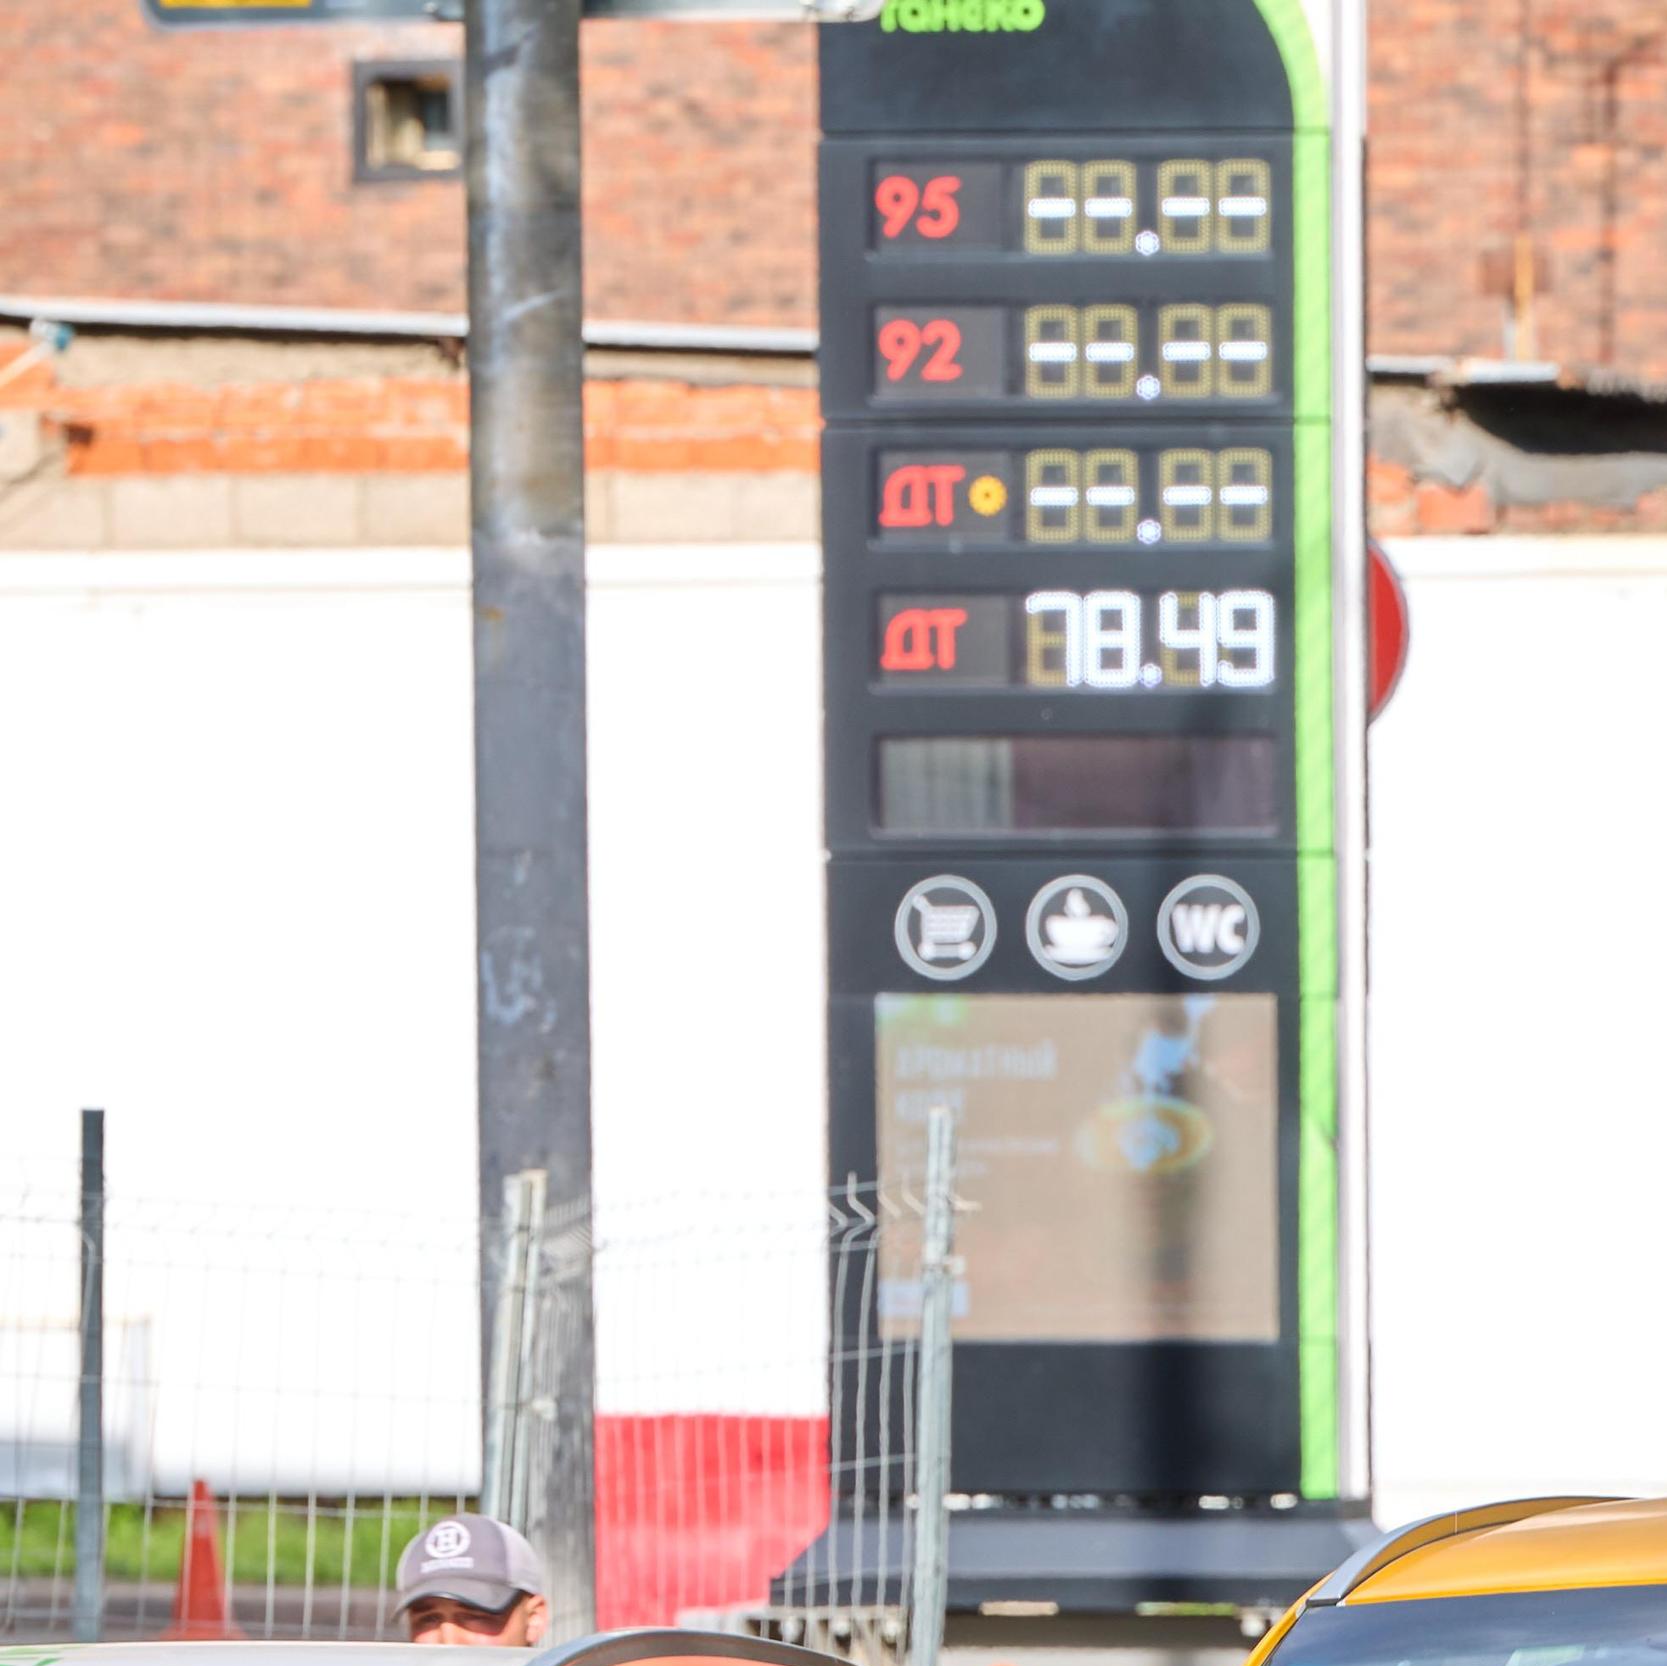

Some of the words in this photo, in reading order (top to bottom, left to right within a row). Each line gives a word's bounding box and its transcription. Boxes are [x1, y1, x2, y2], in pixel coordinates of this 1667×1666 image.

[874, 175, 962, 239] 95
[878, 318, 963, 381] 92
[878, 464, 966, 527] ДТ
[880, 608, 967, 670] ДТ
[1025, 591, 1274, 687] 78.49
[1171, 902, 1246, 956] WC
